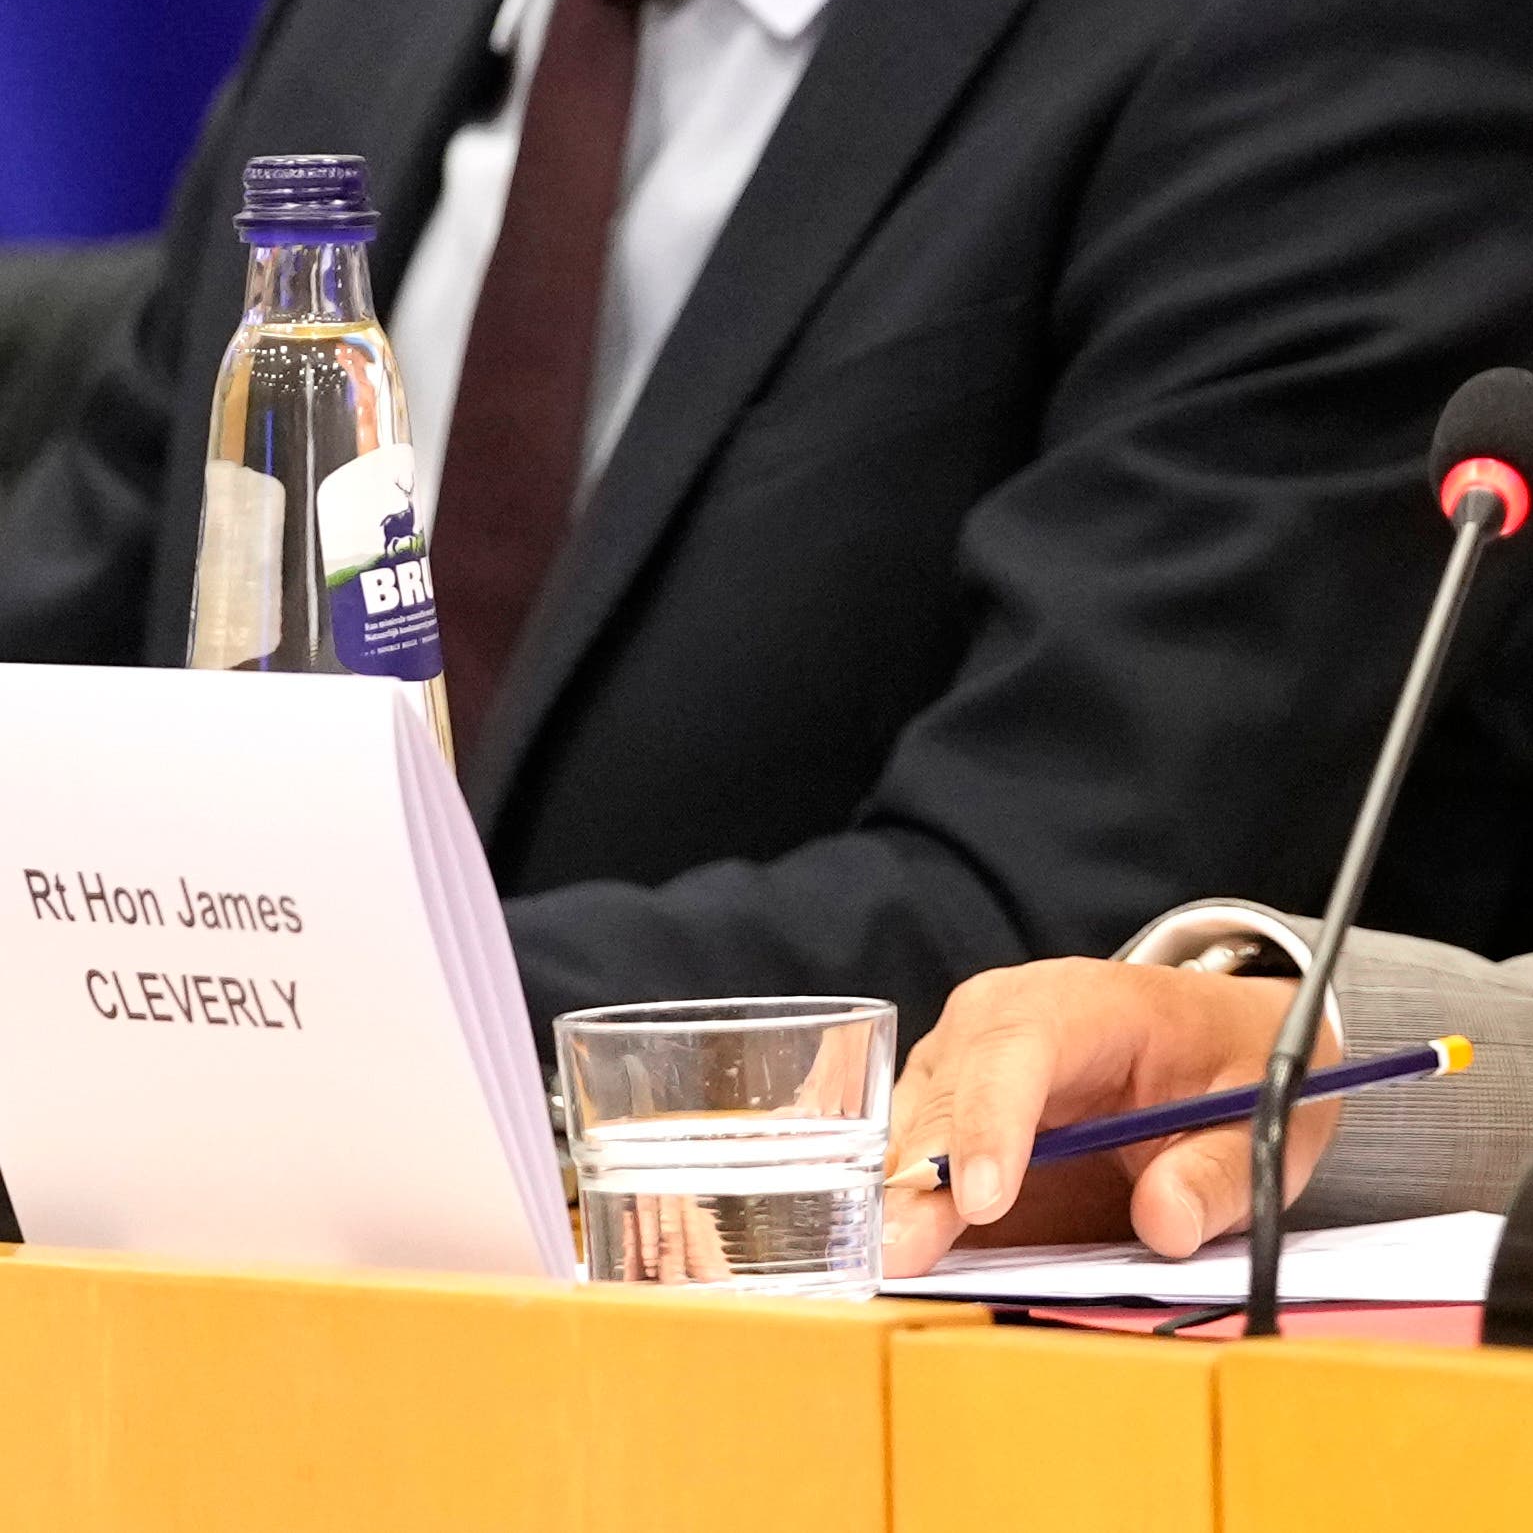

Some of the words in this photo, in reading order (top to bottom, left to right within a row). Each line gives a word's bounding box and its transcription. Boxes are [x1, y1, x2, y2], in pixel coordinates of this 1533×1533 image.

[23, 868, 75, 922] Rt
[77, 870, 164, 926] Hon
[176, 878, 303, 934] James
[85, 969, 303, 1030] CLEVERLY
